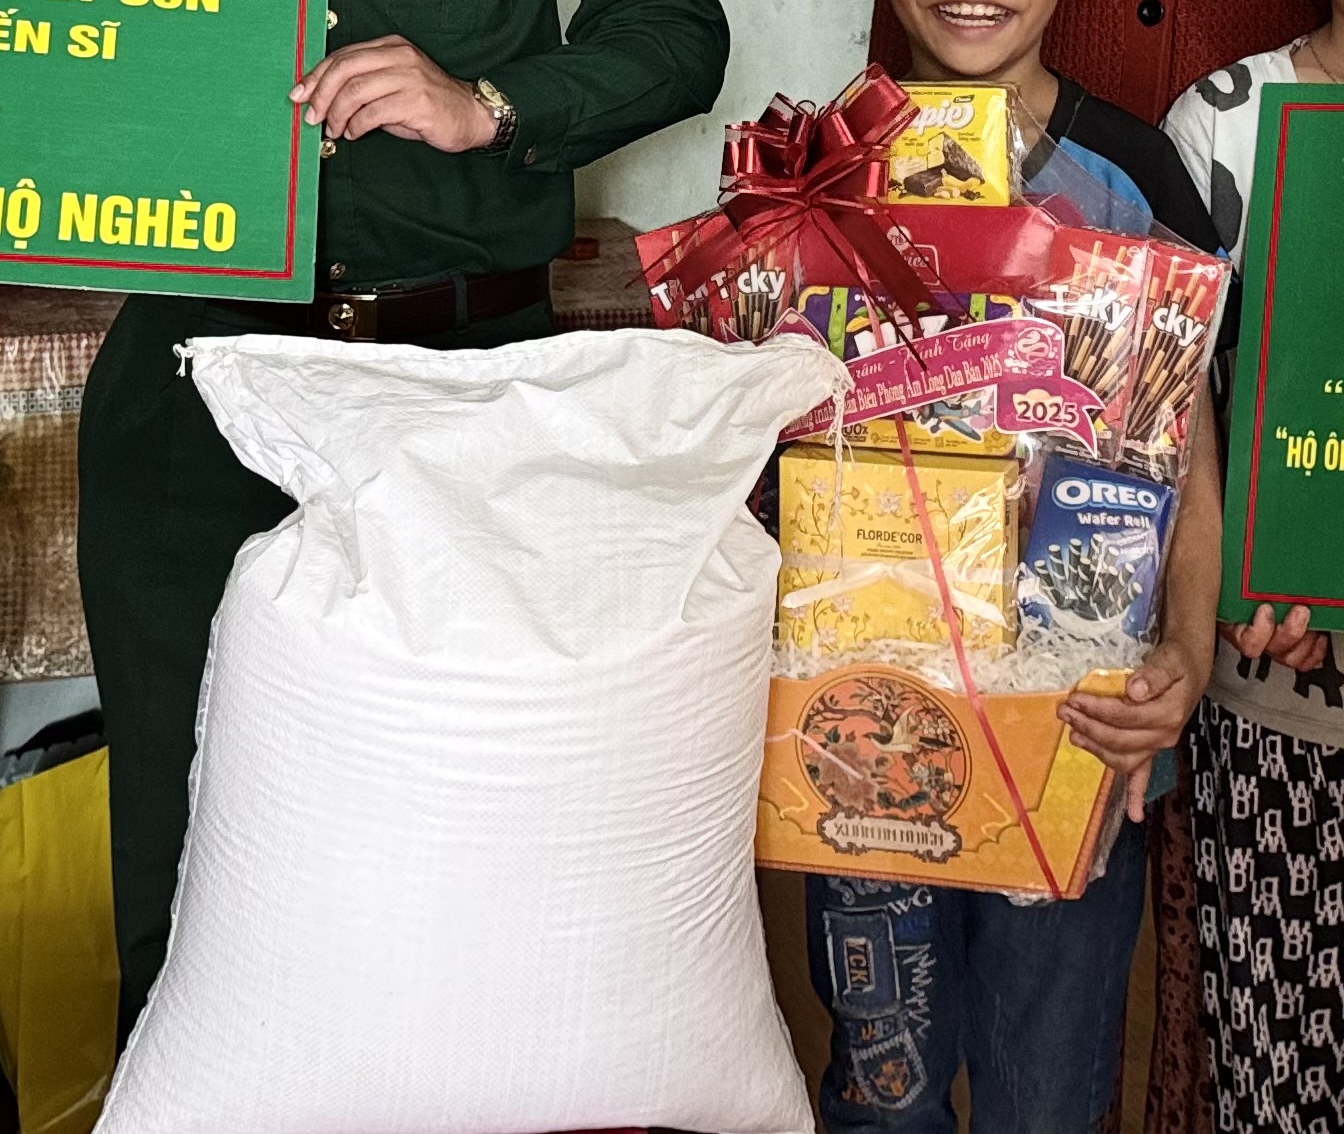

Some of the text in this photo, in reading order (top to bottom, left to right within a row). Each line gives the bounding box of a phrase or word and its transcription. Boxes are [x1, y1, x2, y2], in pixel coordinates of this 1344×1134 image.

[67, 22, 117, 60] SĨ
[58, 187, 237, 253] NGHÈO
[1015, 398, 1078, 425] 2025
[1275, 426, 1318, 477] “HỘ
[1055, 479, 1158, 509] OREO
[1077, 512, 1151, 528] Wafer Roll
